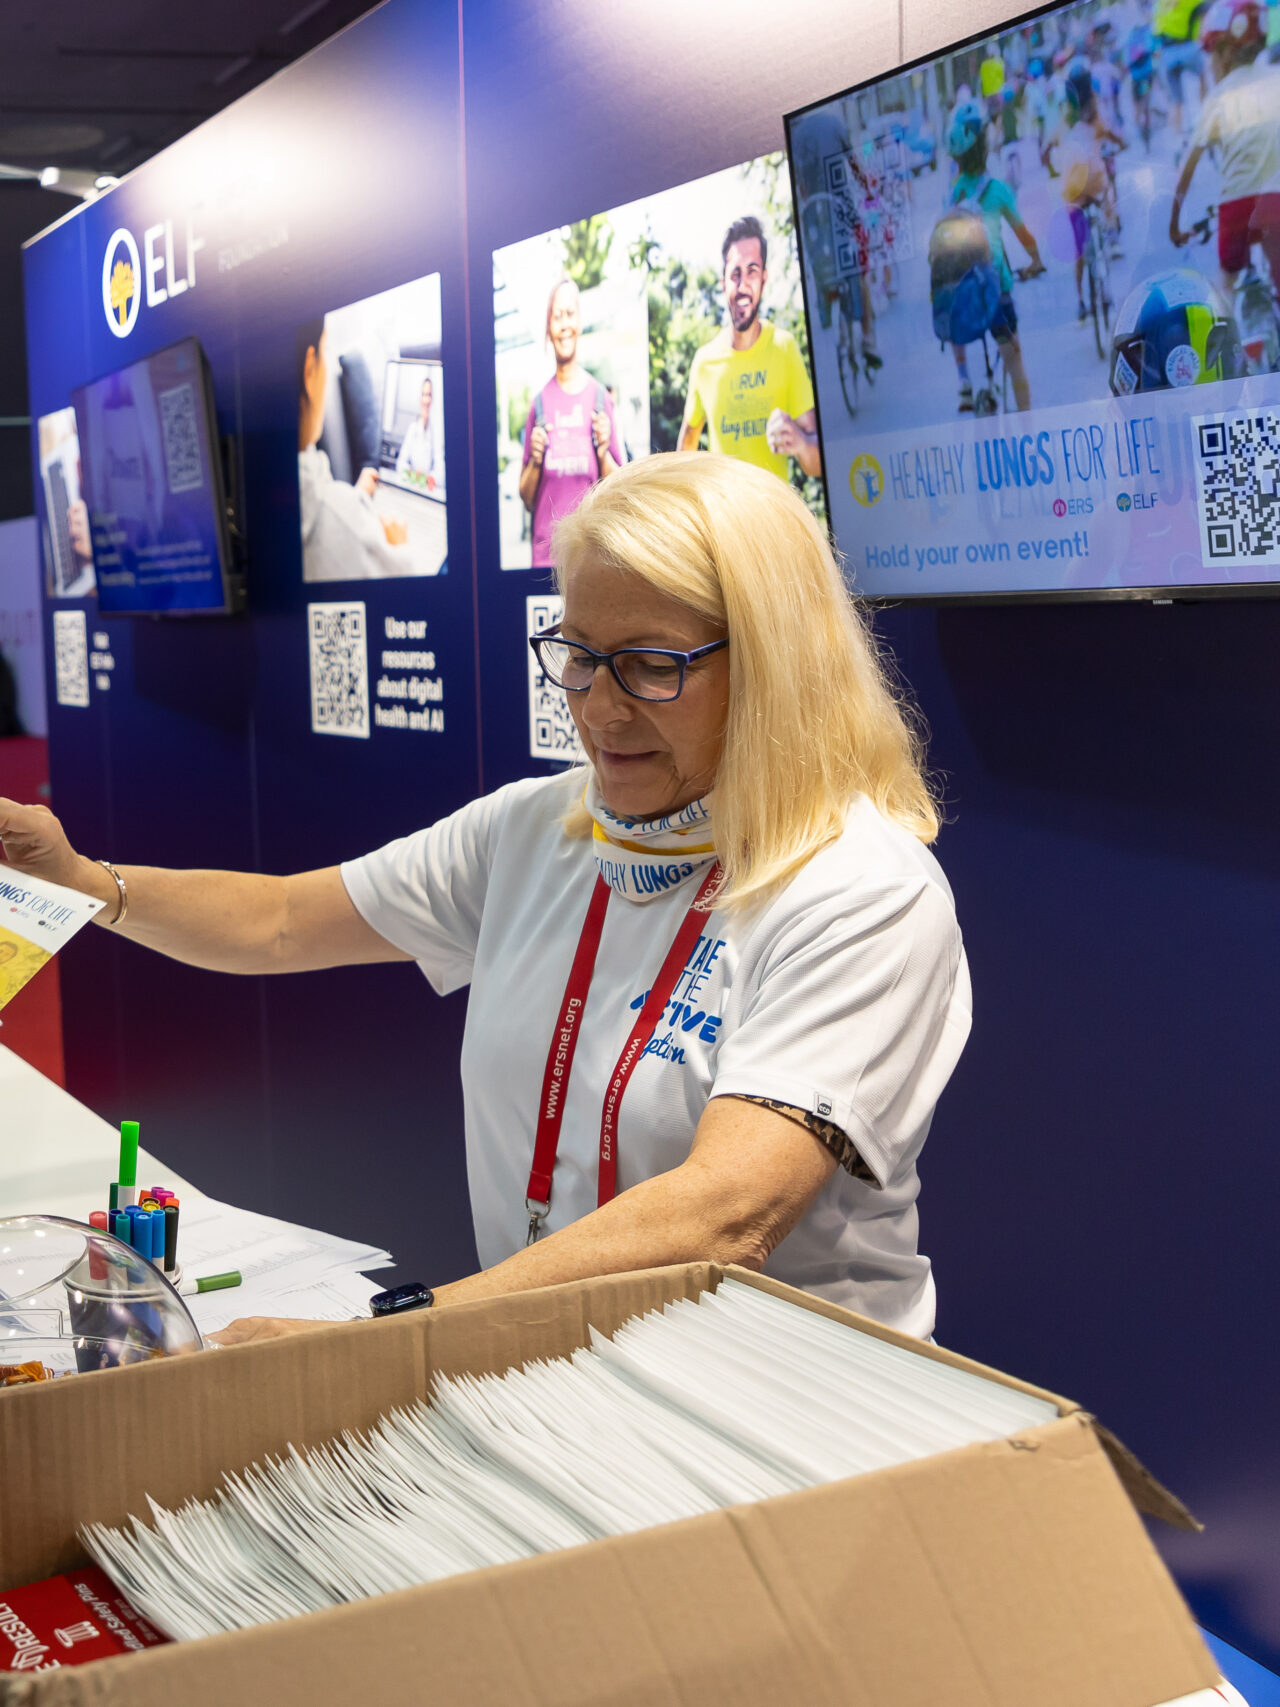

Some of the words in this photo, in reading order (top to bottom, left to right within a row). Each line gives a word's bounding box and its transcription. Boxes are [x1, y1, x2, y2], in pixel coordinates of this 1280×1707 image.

[145, 210, 206, 308] ELF
[738, 369, 768, 391] RUN
[890, 442, 965, 500] HEALTHY
[974, 431, 1054, 492] LUNGS
[1061, 425, 1107, 483] FOR
[1115, 417, 1160, 478] LIFE
[1067, 497, 1094, 515] ERS
[1133, 492, 1158, 509] ELF
[865, 544, 909, 568] Hold
[916, 546, 959, 572] your
[966, 543, 1010, 563] own
[1017, 531, 1089, 560] event!
[385, 616, 407, 639] Use
[407, 620, 427, 639] our
[382, 650, 436, 670] resources
[377, 674, 408, 698] about
[408, 676, 443, 705] digital
[375, 703, 408, 729] health
[408, 706, 430, 731] and
[430, 709, 444, 732] AI
[631, 862, 694, 895] LUNGS
[25, 895, 55, 916] FOR
[48, 905, 77, 926] LIFE
[545, 997, 583, 1120] www.ersnet.org
[601, 1037, 642, 1161] www.ersnet.org
[73, 1582, 99, 1602] Pins
[90, 1600, 126, 1630] Safety
